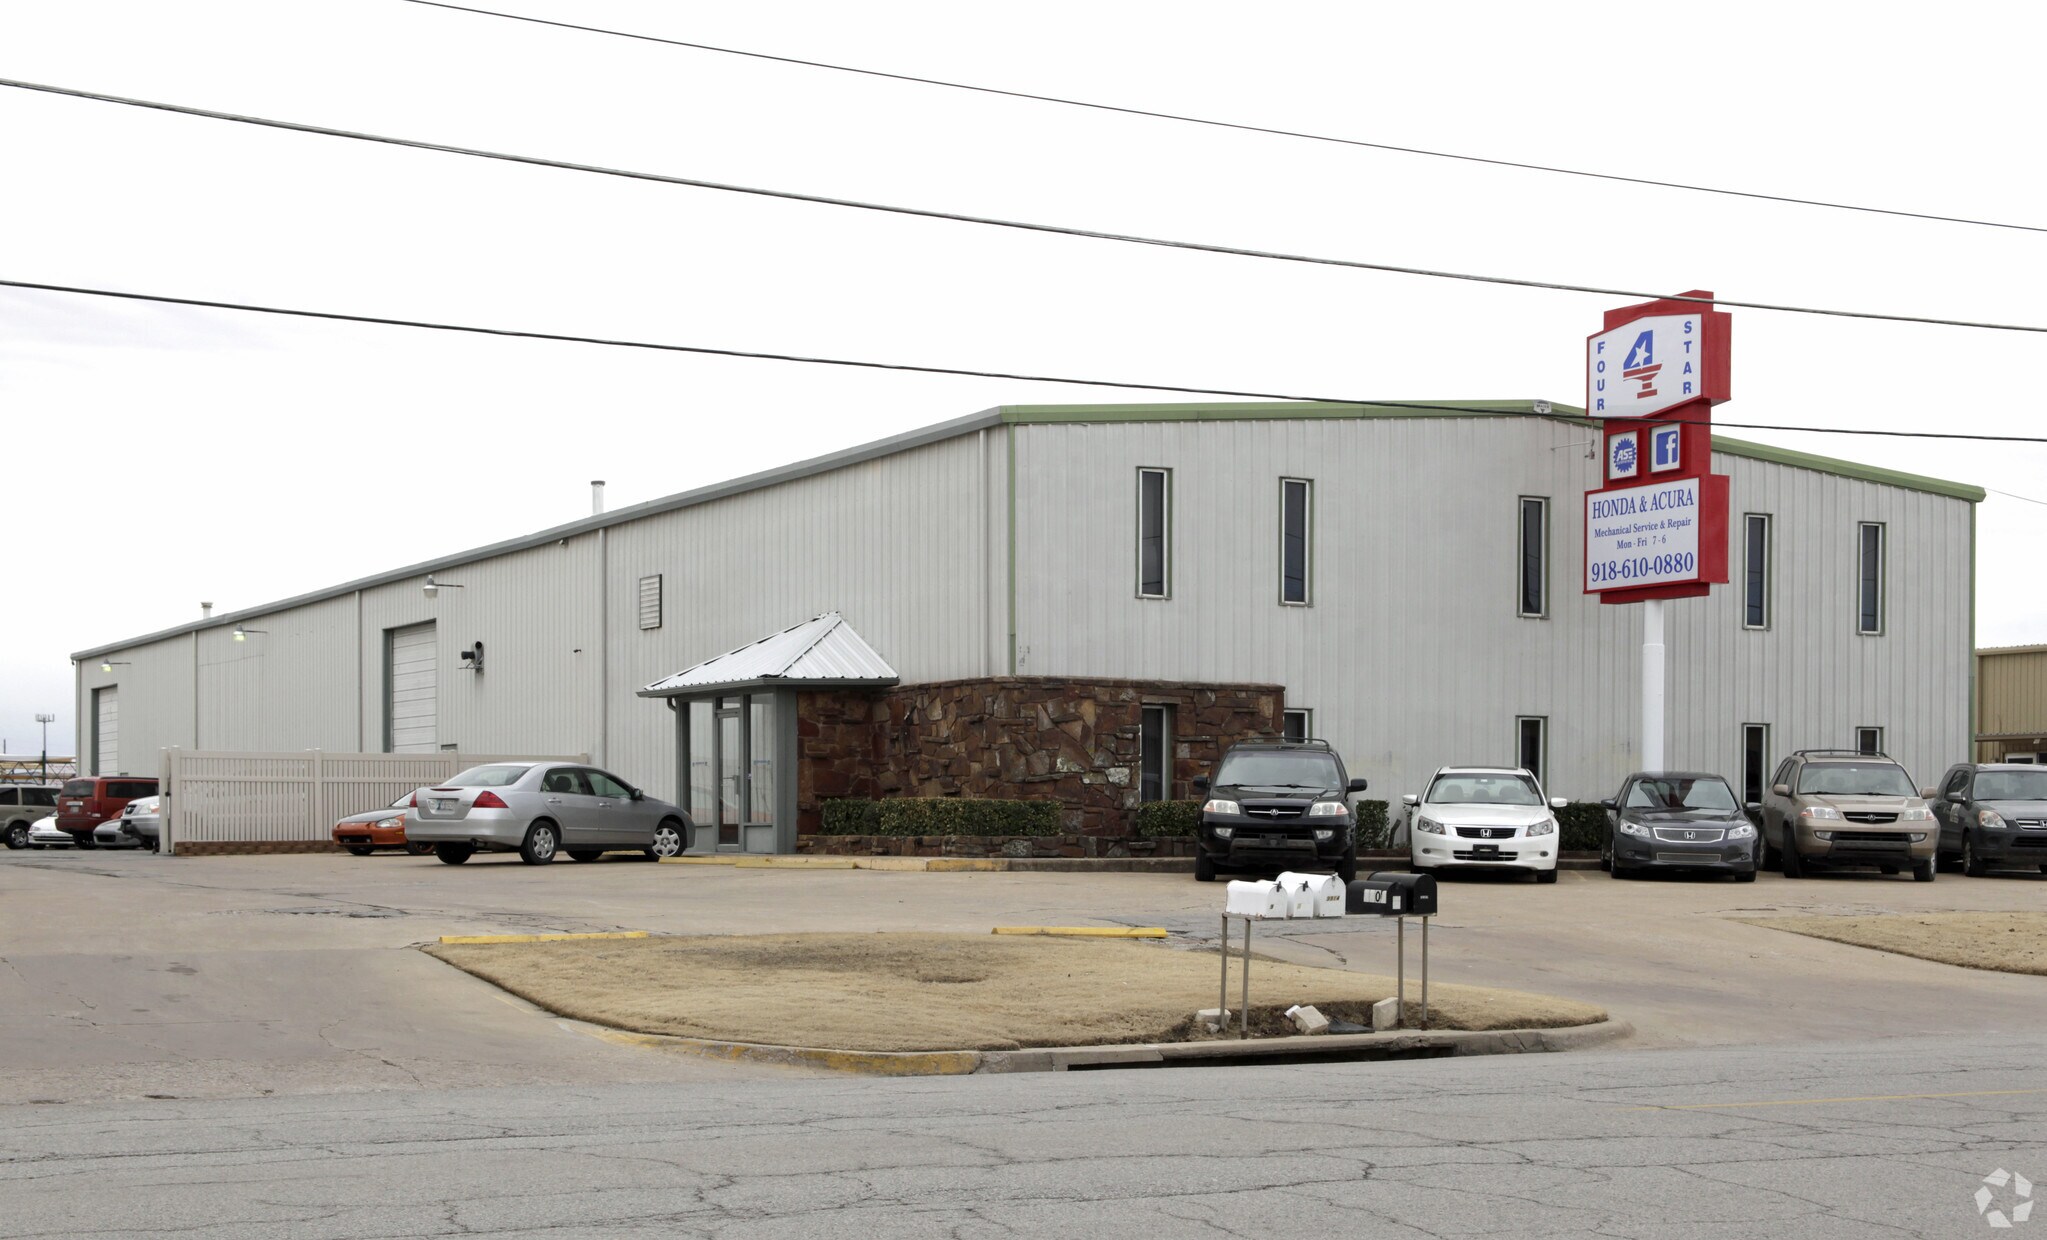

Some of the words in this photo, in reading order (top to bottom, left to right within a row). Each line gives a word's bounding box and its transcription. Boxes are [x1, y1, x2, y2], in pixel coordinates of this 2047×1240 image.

[1683, 321, 1692, 394] STAR
[1597, 341, 1605, 411] FOUR
[1617, 448, 1633, 461] ASE
[1592, 497, 1636, 519] HONDA
[1639, 495, 1647, 512] &
[1650, 488, 1694, 511] ACURA
[1594, 524, 1631, 538] Mechanical
[1632, 523, 1658, 533] Service
[1660, 520, 1665, 529] &
[1667, 517, 1691, 530] Repair
[1616, 540, 1632, 550] Mon
[1637, 537, 1647, 547] Fri
[1662, 535, 1666, 544] 6
[1591, 551, 1694, 582] 918-610-0880
